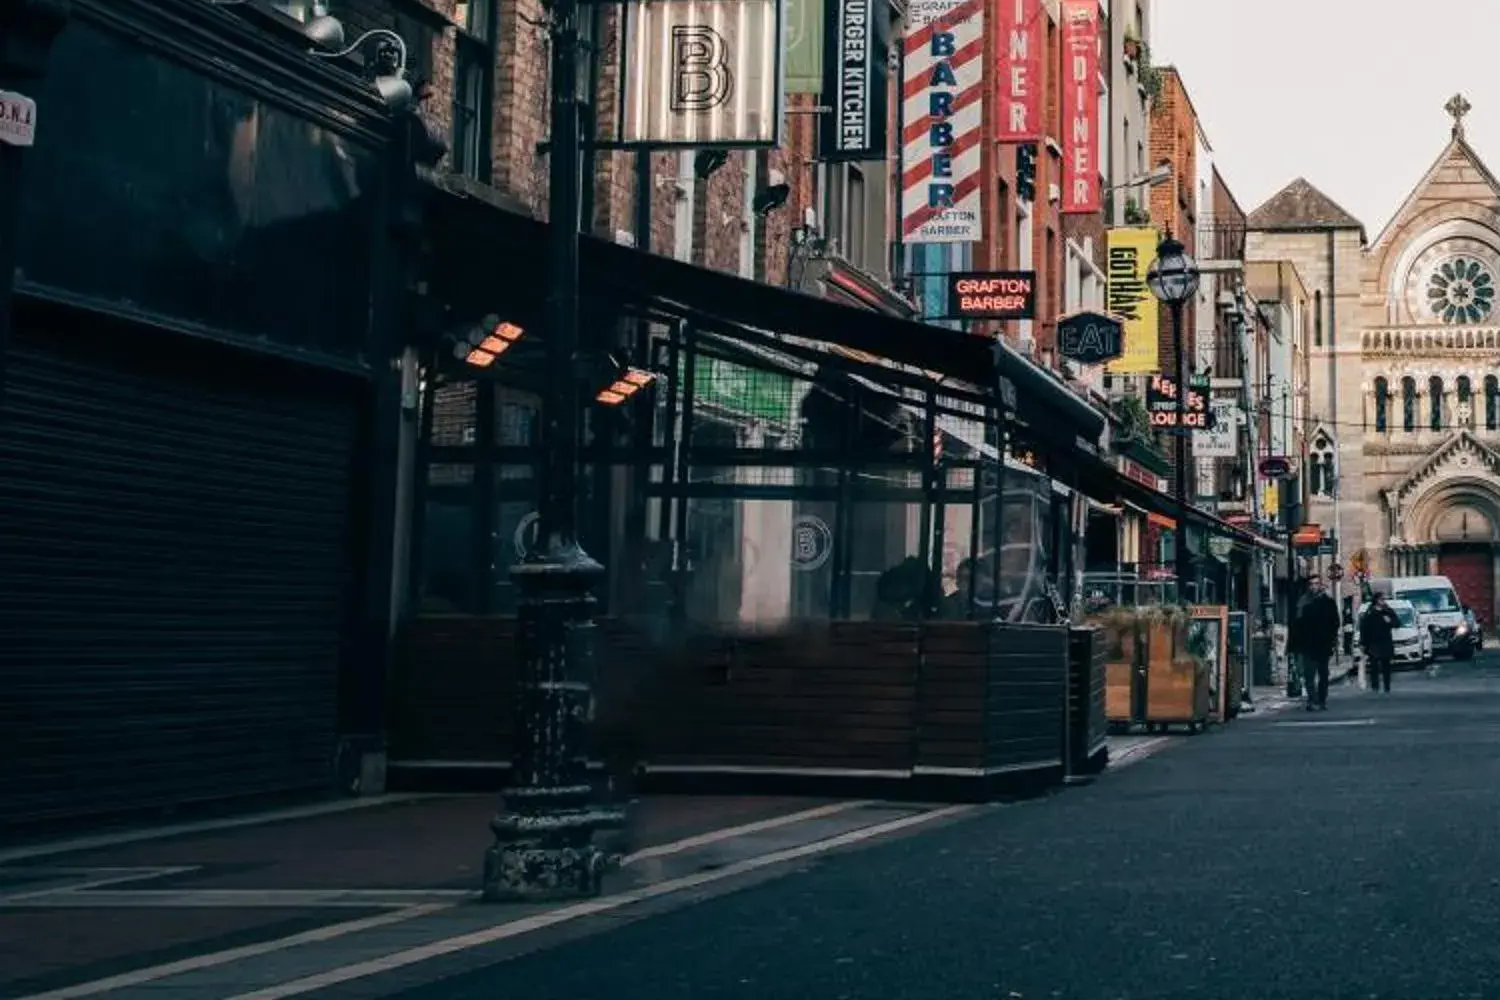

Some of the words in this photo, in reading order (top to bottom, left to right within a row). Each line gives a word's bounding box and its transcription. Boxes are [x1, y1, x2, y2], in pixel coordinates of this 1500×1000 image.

[671, 25, 732, 111] B
[843, 68, 865, 150] KITCHEN
[929, 32, 956, 208] BARBER
[1073, 56, 1088, 203] DINER
[956, 279, 1031, 293] GRAFTON
[960, 296, 1025, 310] BARBER
[1061, 323, 1119, 355] EAT
